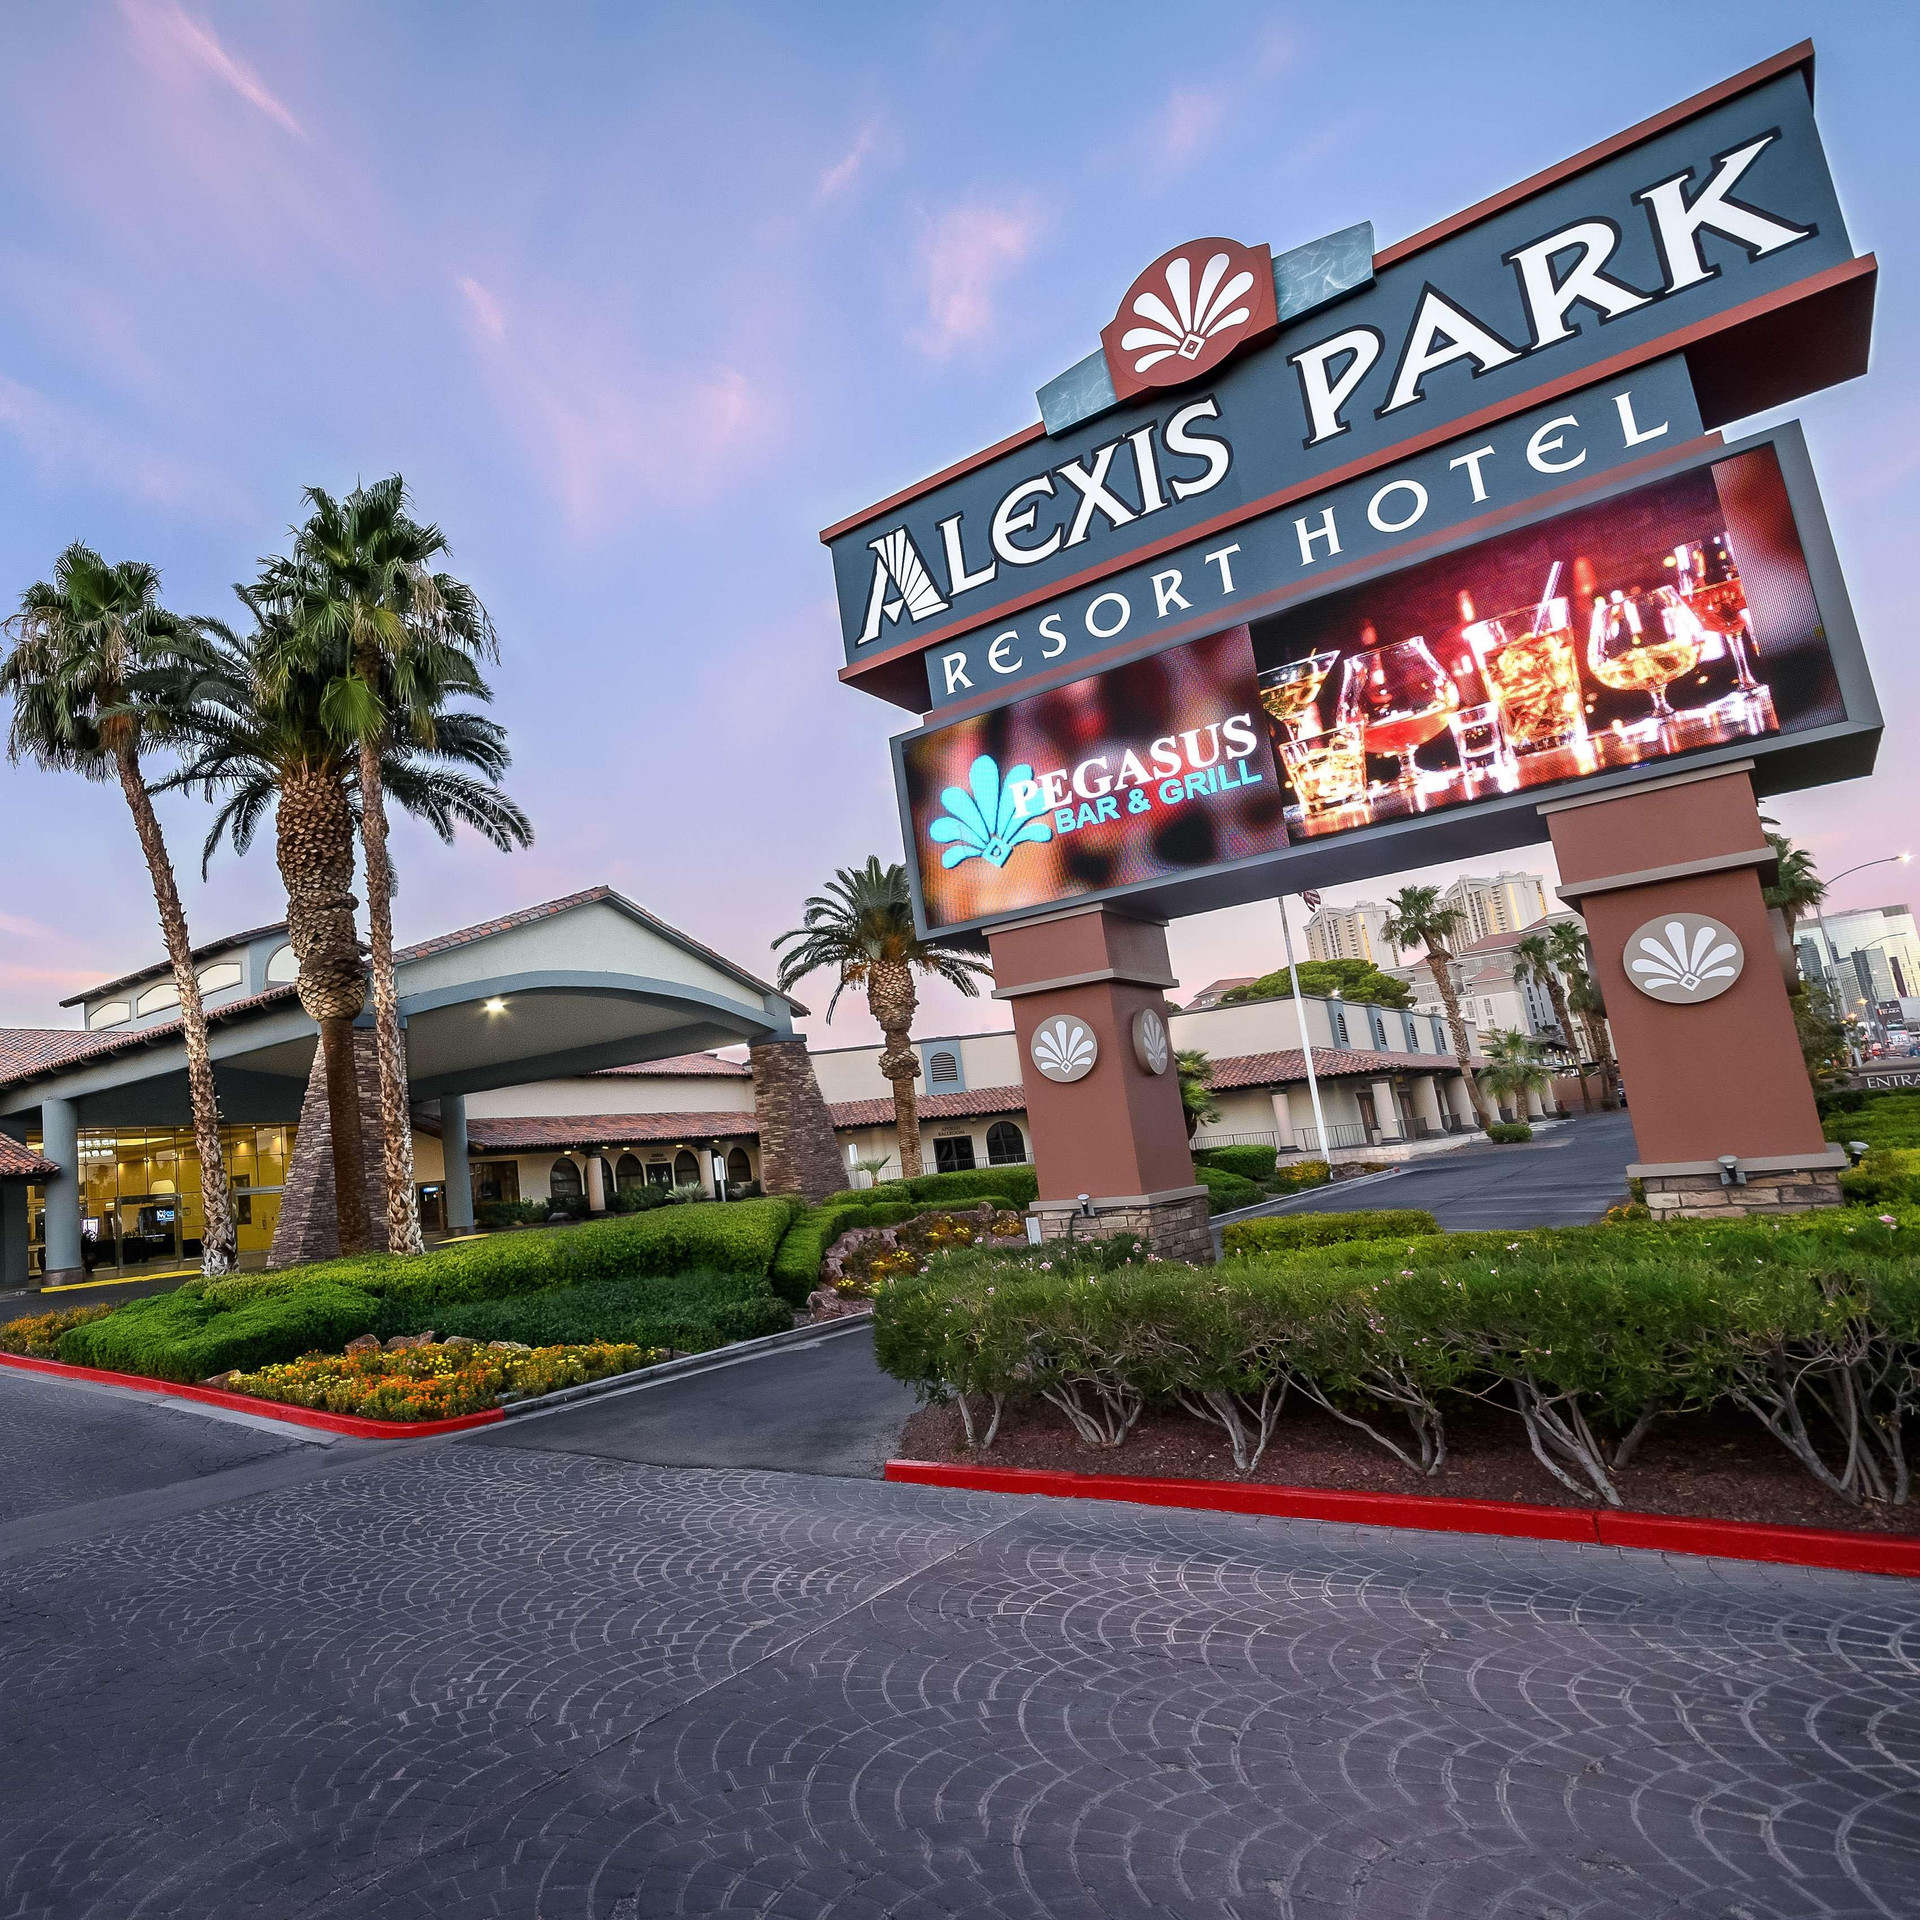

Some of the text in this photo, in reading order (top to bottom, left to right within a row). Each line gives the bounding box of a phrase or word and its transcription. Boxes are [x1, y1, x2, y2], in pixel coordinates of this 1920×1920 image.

[856, 135, 1810, 645] ALEXIS PARK
[940, 390, 1670, 696] RESORT HOTEL
[1009, 713, 1257, 819] PEGASUS
[1055, 759, 1263, 835] BAR & GRILL
